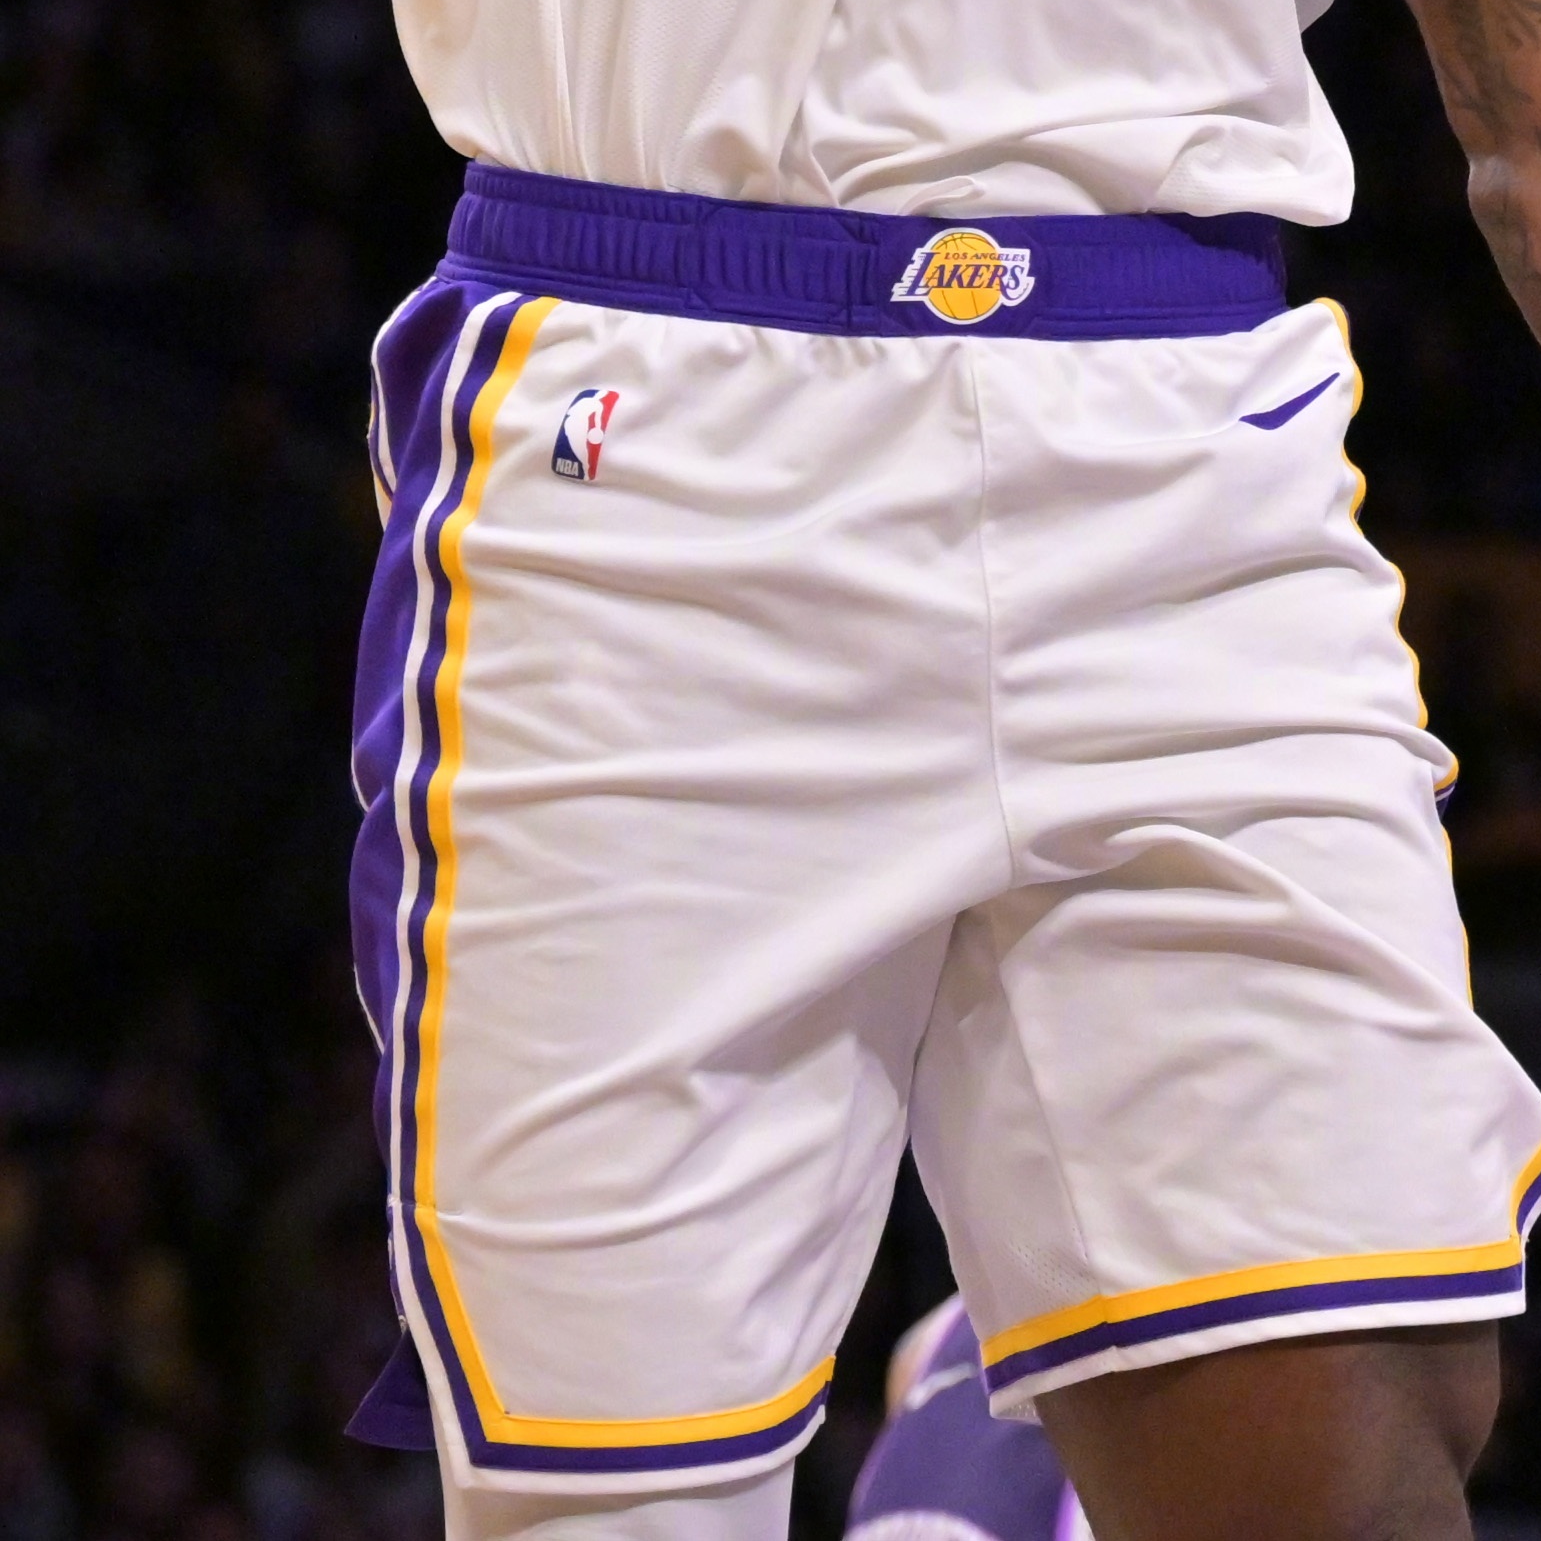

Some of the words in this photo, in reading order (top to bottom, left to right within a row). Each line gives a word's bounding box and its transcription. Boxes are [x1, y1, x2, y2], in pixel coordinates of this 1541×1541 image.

[944, 252, 968, 260] LOS
[970, 252, 1026, 262] ANGELES
[898, 252, 1030, 301] LAKERS
[555, 457, 579, 477] NBA
